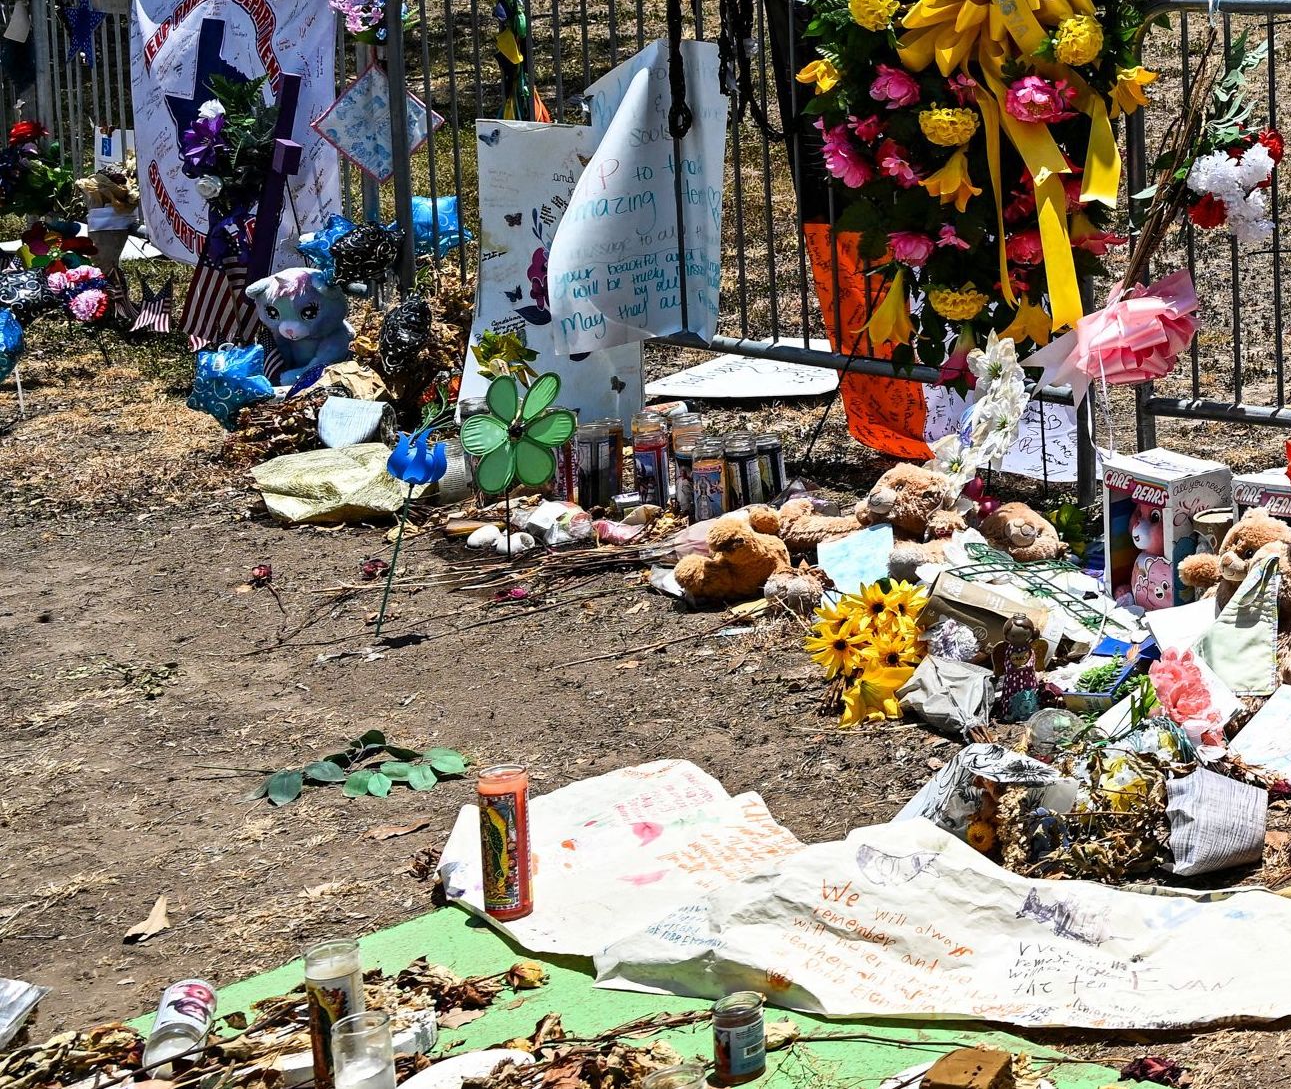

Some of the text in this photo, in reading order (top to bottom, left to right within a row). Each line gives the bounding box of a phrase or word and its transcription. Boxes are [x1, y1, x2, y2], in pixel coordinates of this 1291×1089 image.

[148, 160, 197, 254] SUPPORT
[573, 280, 600, 301] will
[607, 277, 622, 292] be
[561, 311, 607, 339] May
[618, 298, 649, 329] they
[1104, 469, 1169, 507] CARE BEARS
[1233, 484, 1267, 504] CARE
[821, 878, 860, 908] We
[874, 907, 909, 926] will
[900, 952, 940, 975] and
